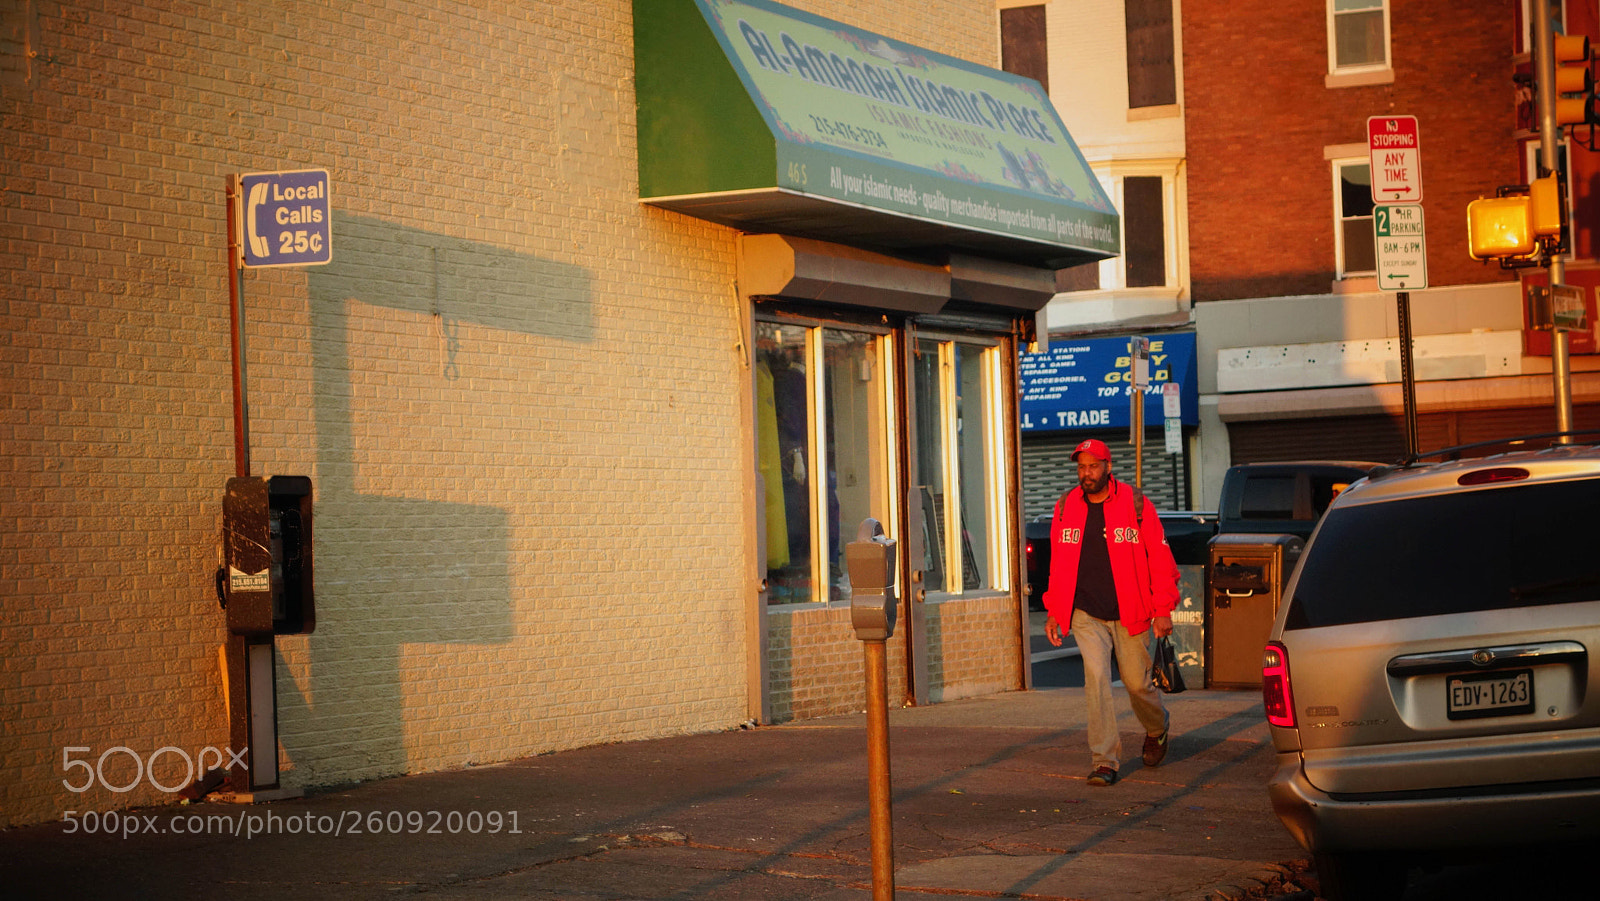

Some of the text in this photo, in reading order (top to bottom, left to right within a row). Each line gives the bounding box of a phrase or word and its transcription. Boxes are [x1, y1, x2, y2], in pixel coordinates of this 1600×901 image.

[808, 113, 888, 149] 215-476-3734
[865, 102, 927, 134] ISLAMIC
[926, 118, 993, 151] FASHIONS
[1386, 120, 1398, 132] NO
[1373, 134, 1414, 147] STOPPING
[1384, 153, 1405, 166] ANY
[787, 161, 800, 183] 46
[1384, 168, 1408, 182] TIME
[273, 181, 324, 201] Local
[830, 166, 842, 189] All
[843, 175, 863, 196] your
[863, 174, 892, 200] islamic
[894, 184, 918, 206] needs
[922, 190, 950, 217] quality
[951, 197, 997, 222] merchandise
[997, 204, 1029, 229] imported
[1030, 212, 1048, 232] from
[1048, 214, 1056, 233] all
[1057, 219, 1073, 239] parts
[1074, 219, 1082, 237] of
[1081, 222, 1093, 239] the
[1093, 224, 1114, 244] world.
[275, 206, 323, 225] Calls
[1378, 211, 1387, 232] 2
[1399, 209, 1412, 219] HR
[1391, 222, 1421, 233] PARKING
[279, 230, 322, 254] 25¢
[1053, 346, 1090, 354] STATIONS
[1115, 354, 1168, 368] BY
[1024, 393, 1062, 401] REPAIRED
[1097, 386, 1120, 397] TOP
[1057, 409, 1110, 427] TRADE
[1058, 527, 1140, 543] ED SOX
